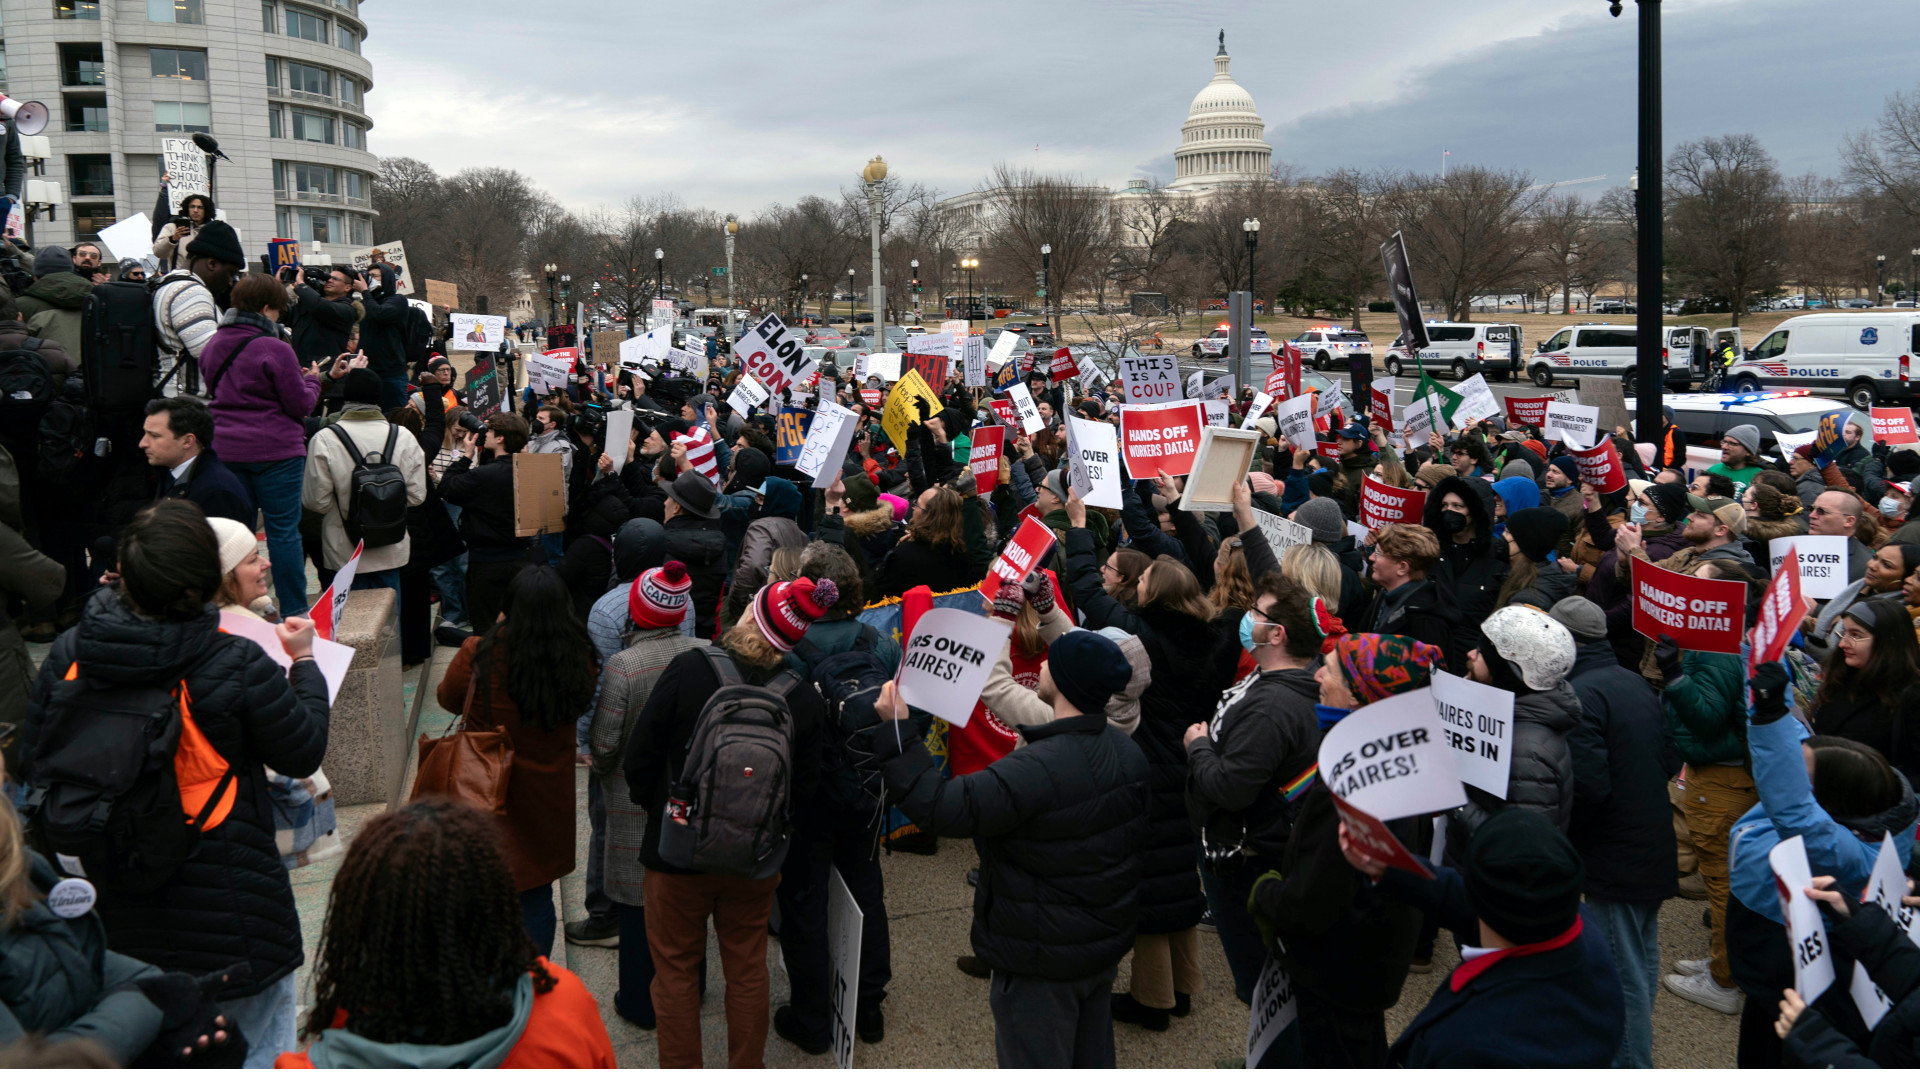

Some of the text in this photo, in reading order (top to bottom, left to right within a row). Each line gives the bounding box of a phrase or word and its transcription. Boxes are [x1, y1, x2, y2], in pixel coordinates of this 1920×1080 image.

[165, 139, 176, 151] IF
[164, 151, 200, 164] THINK
[167, 161, 199, 173] IS BAD
[168, 181, 200, 191] WHAT
[388, 247, 402, 255] CAN
[354, 253, 370, 264] ONLY
[389, 253, 404, 263] STOP
[1488, 332, 1510, 340] POL
[1672, 336, 1691, 345] POL
[756, 314, 812, 376] ELON
[1124, 358, 1174, 372] THIS
[1573, 359, 1608, 367] POLICE
[747, 350, 793, 396] CON
[902, 352, 949, 388] IMPEACH
[1130, 371, 1169, 382] IS A
[1790, 368, 1839, 377] POLICE
[746, 388, 760, 403] OVER
[1131, 382, 1176, 399] COUP
[1018, 396, 1031, 409] OUT
[1025, 408, 1035, 419] IN
[1294, 409, 1309, 421] OVER
[1424, 405, 1437, 417] OER
[1548, 412, 1594, 425] WORKERS OVER
[1128, 425, 1189, 442] HANDS OFF
[1888, 425, 1911, 434] DATA!
[985, 444, 997, 457] OFF
[1128, 439, 1195, 458] WORKERS DATA!
[1082, 449, 1109, 463] OVER
[1364, 485, 1406, 508] NOBODY
[1363, 498, 1404, 520] ELECTED
[1257, 510, 1308, 545] TAKE YOUR
[1807, 553, 1841, 564] OVER
[1640, 580, 1728, 615] HANDS OFF
[1638, 595, 1731, 632] WORKERS DATA!
[934, 637, 986, 667] OVER
[1478, 713, 1506, 739] OUT
[1360, 727, 1431, 760] OVER
[1480, 740, 1500, 763] IN
